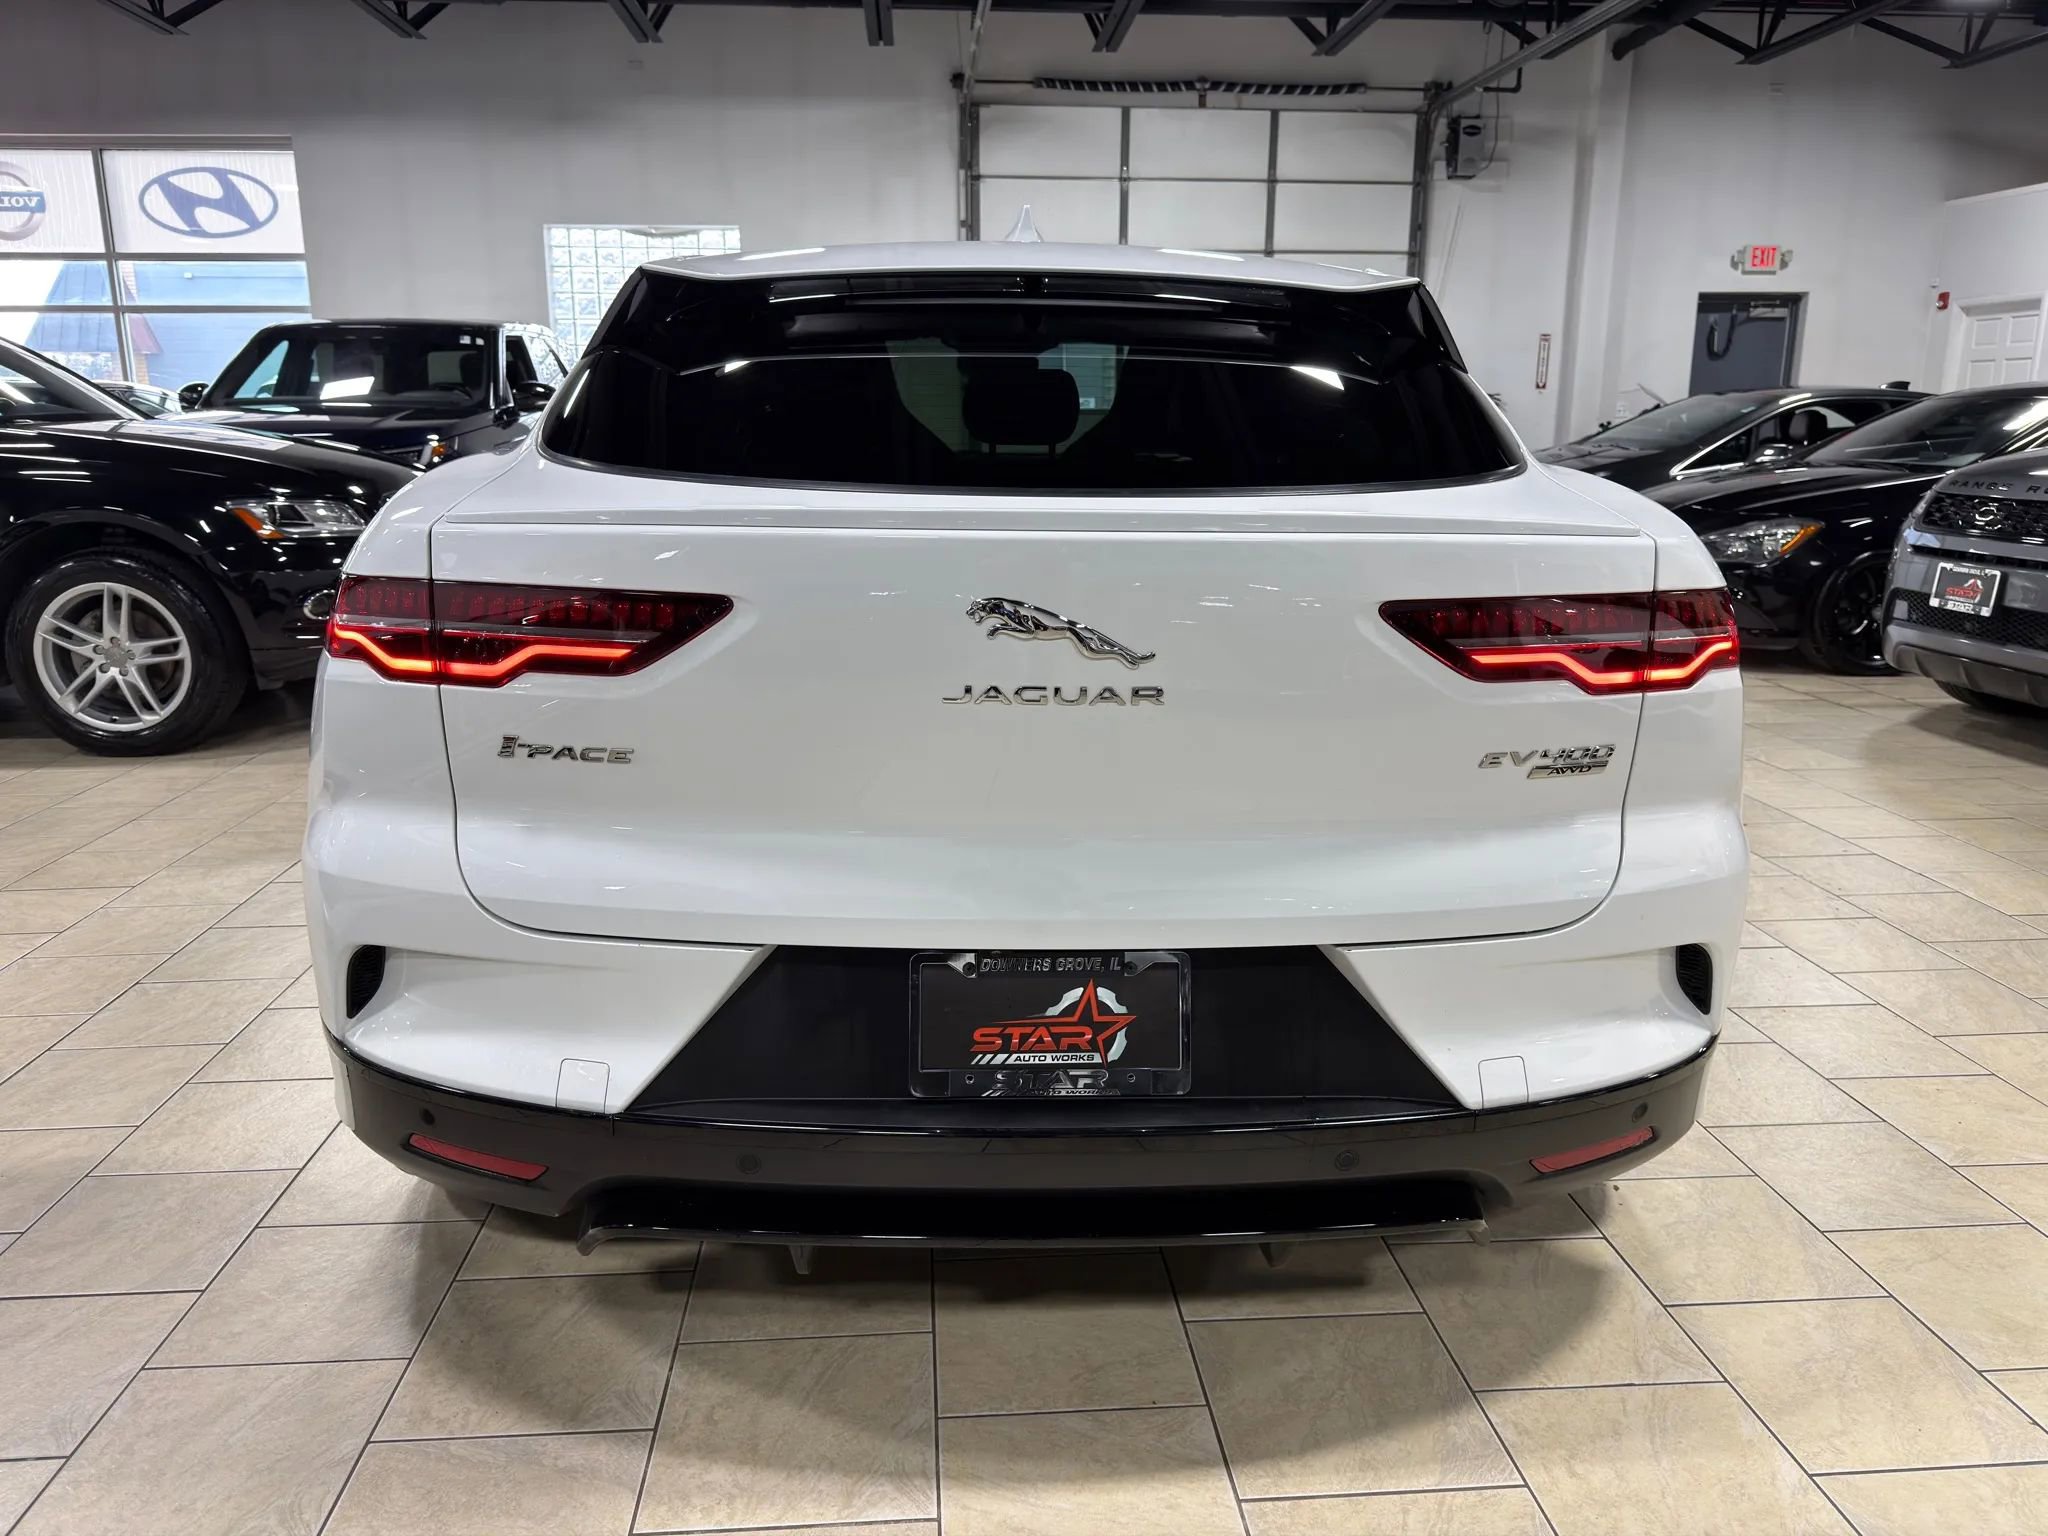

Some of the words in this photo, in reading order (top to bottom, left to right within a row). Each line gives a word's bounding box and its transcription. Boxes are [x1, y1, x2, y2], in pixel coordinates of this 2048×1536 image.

[1751, 246, 1777, 268] EXIT
[1948, 480, 2014, 491] RANGE
[942, 685, 1165, 707] JAGUAR
[497, 734, 635, 764] I-PACE
[1547, 765, 1593, 776] AWD
[1056, 956, 1104, 972] GROVE,
[1109, 956, 1122, 971] IL
[970, 1025, 1093, 1052] STAR
[1013, 1054, 1047, 1063] AUTO
[1051, 1053, 1095, 1062] WORKS
[991, 1068, 1109, 1090] STAR
